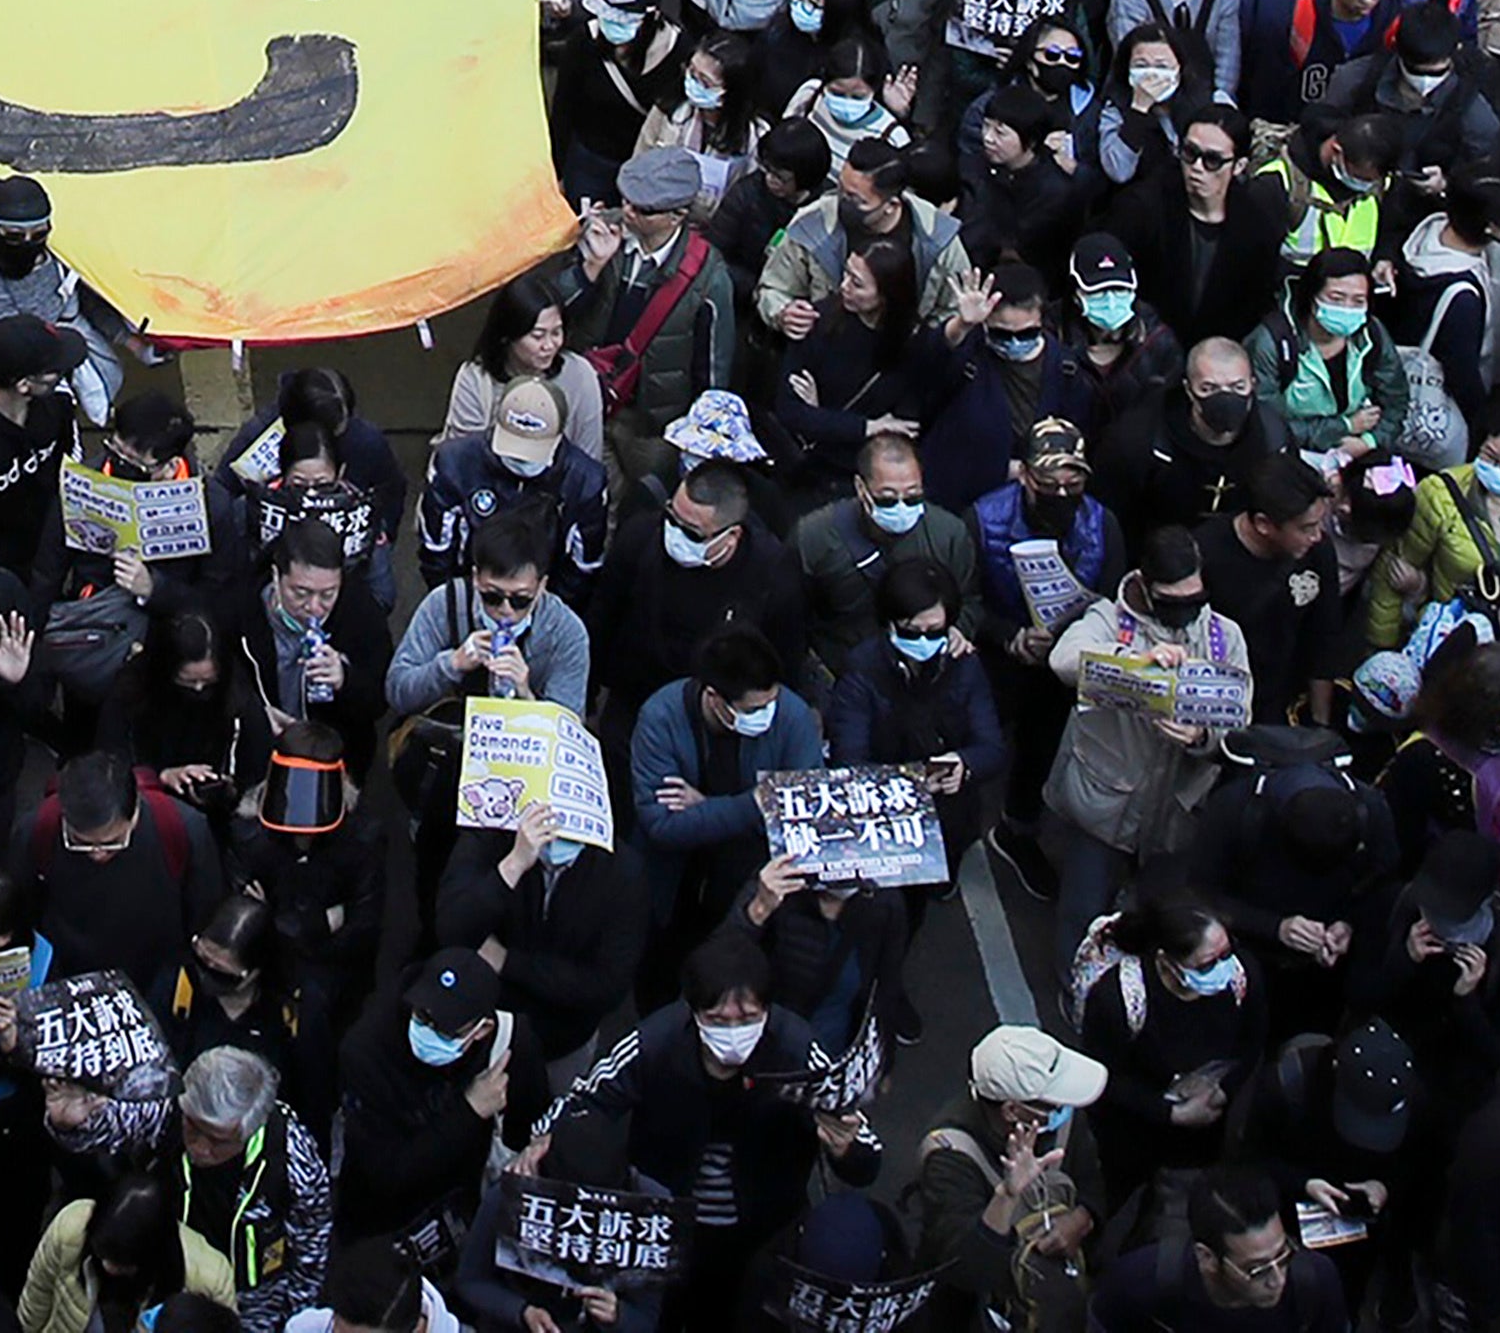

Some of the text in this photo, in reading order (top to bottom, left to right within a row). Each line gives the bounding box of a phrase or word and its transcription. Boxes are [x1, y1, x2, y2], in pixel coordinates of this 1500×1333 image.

[471, 717, 503, 731] Five
[775, 780, 915, 823] 五大訴求
[521, 1190, 671, 1240] 五大訴求
